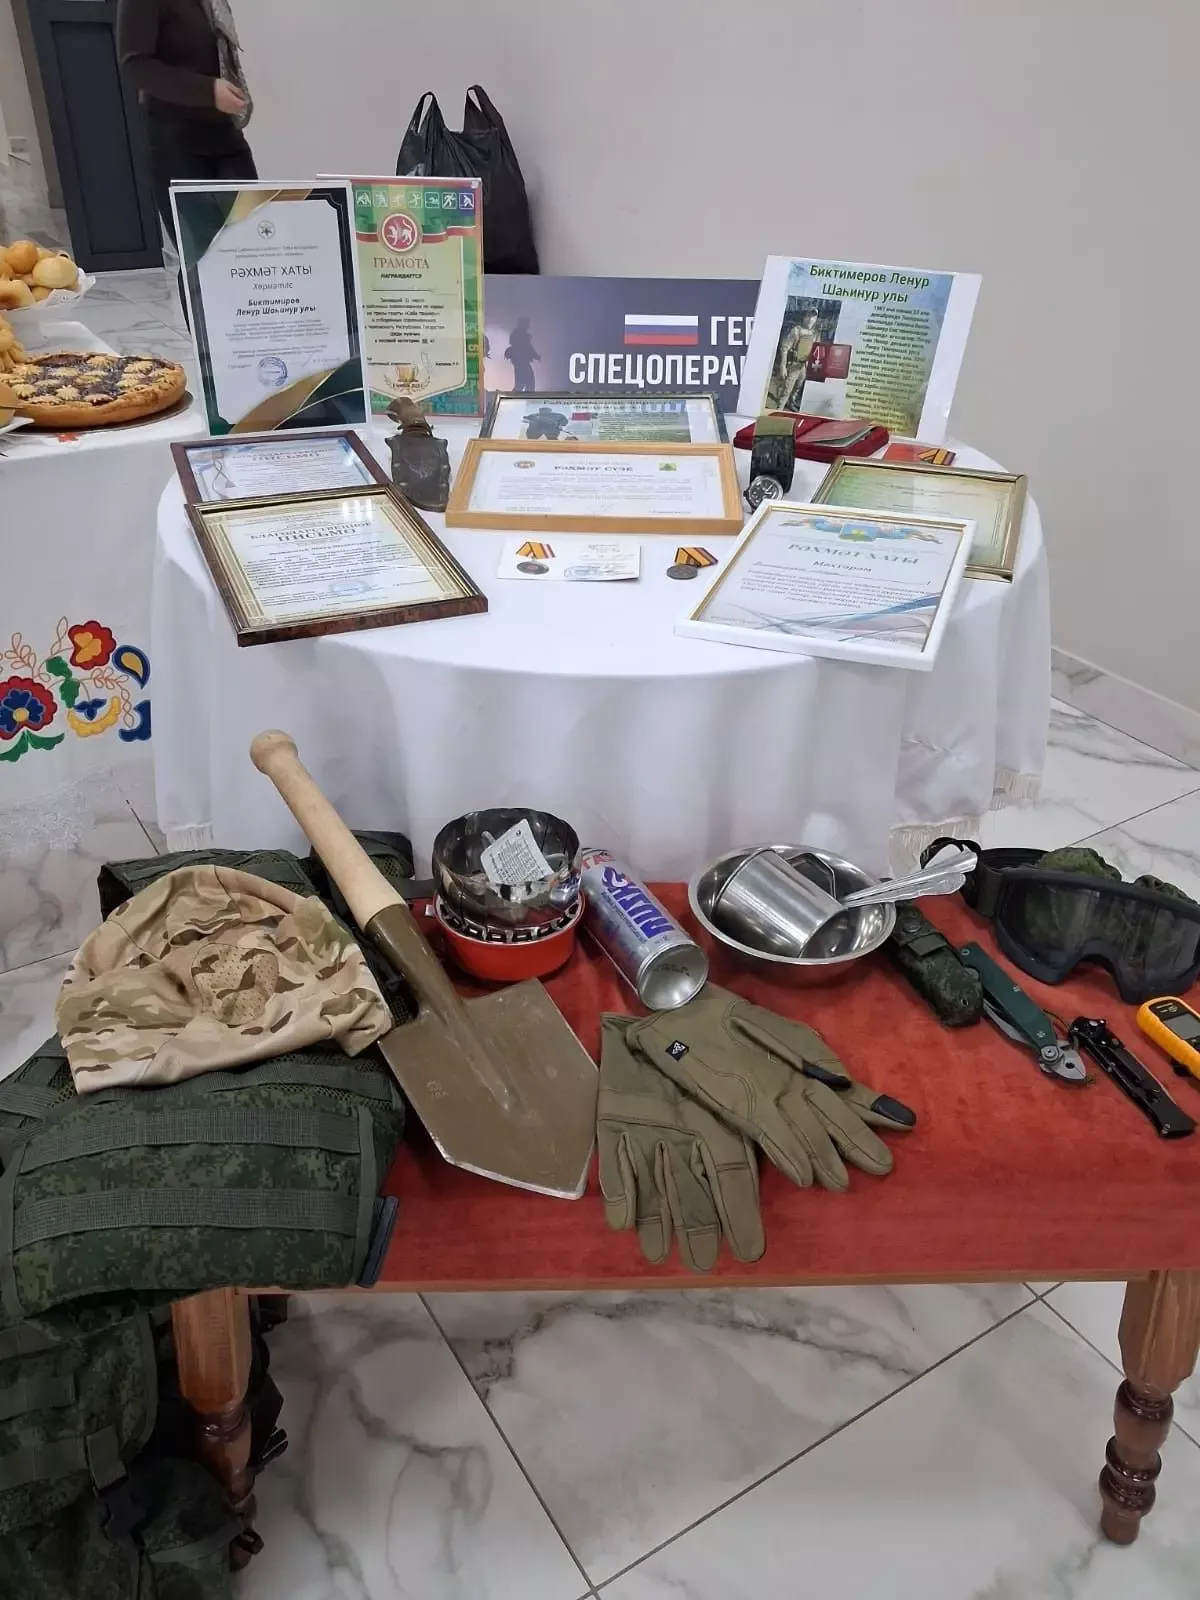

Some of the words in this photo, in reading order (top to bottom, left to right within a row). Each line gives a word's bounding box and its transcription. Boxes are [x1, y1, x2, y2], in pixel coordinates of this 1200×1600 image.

[373, 257, 430, 269] ГРАМОТА
[280, 265, 312, 276] ХАТЫ
[810, 264, 886, 283] Биктимеров
[889, 272, 930, 288] Ленур
[882, 291, 908, 303] улы
[236, 308, 260, 316] Ленур
[300, 305, 316, 314] улы
[568, 352, 747, 389] СПЕЦОПЕРА
[278, 528, 356, 542] ПИСЬМО
